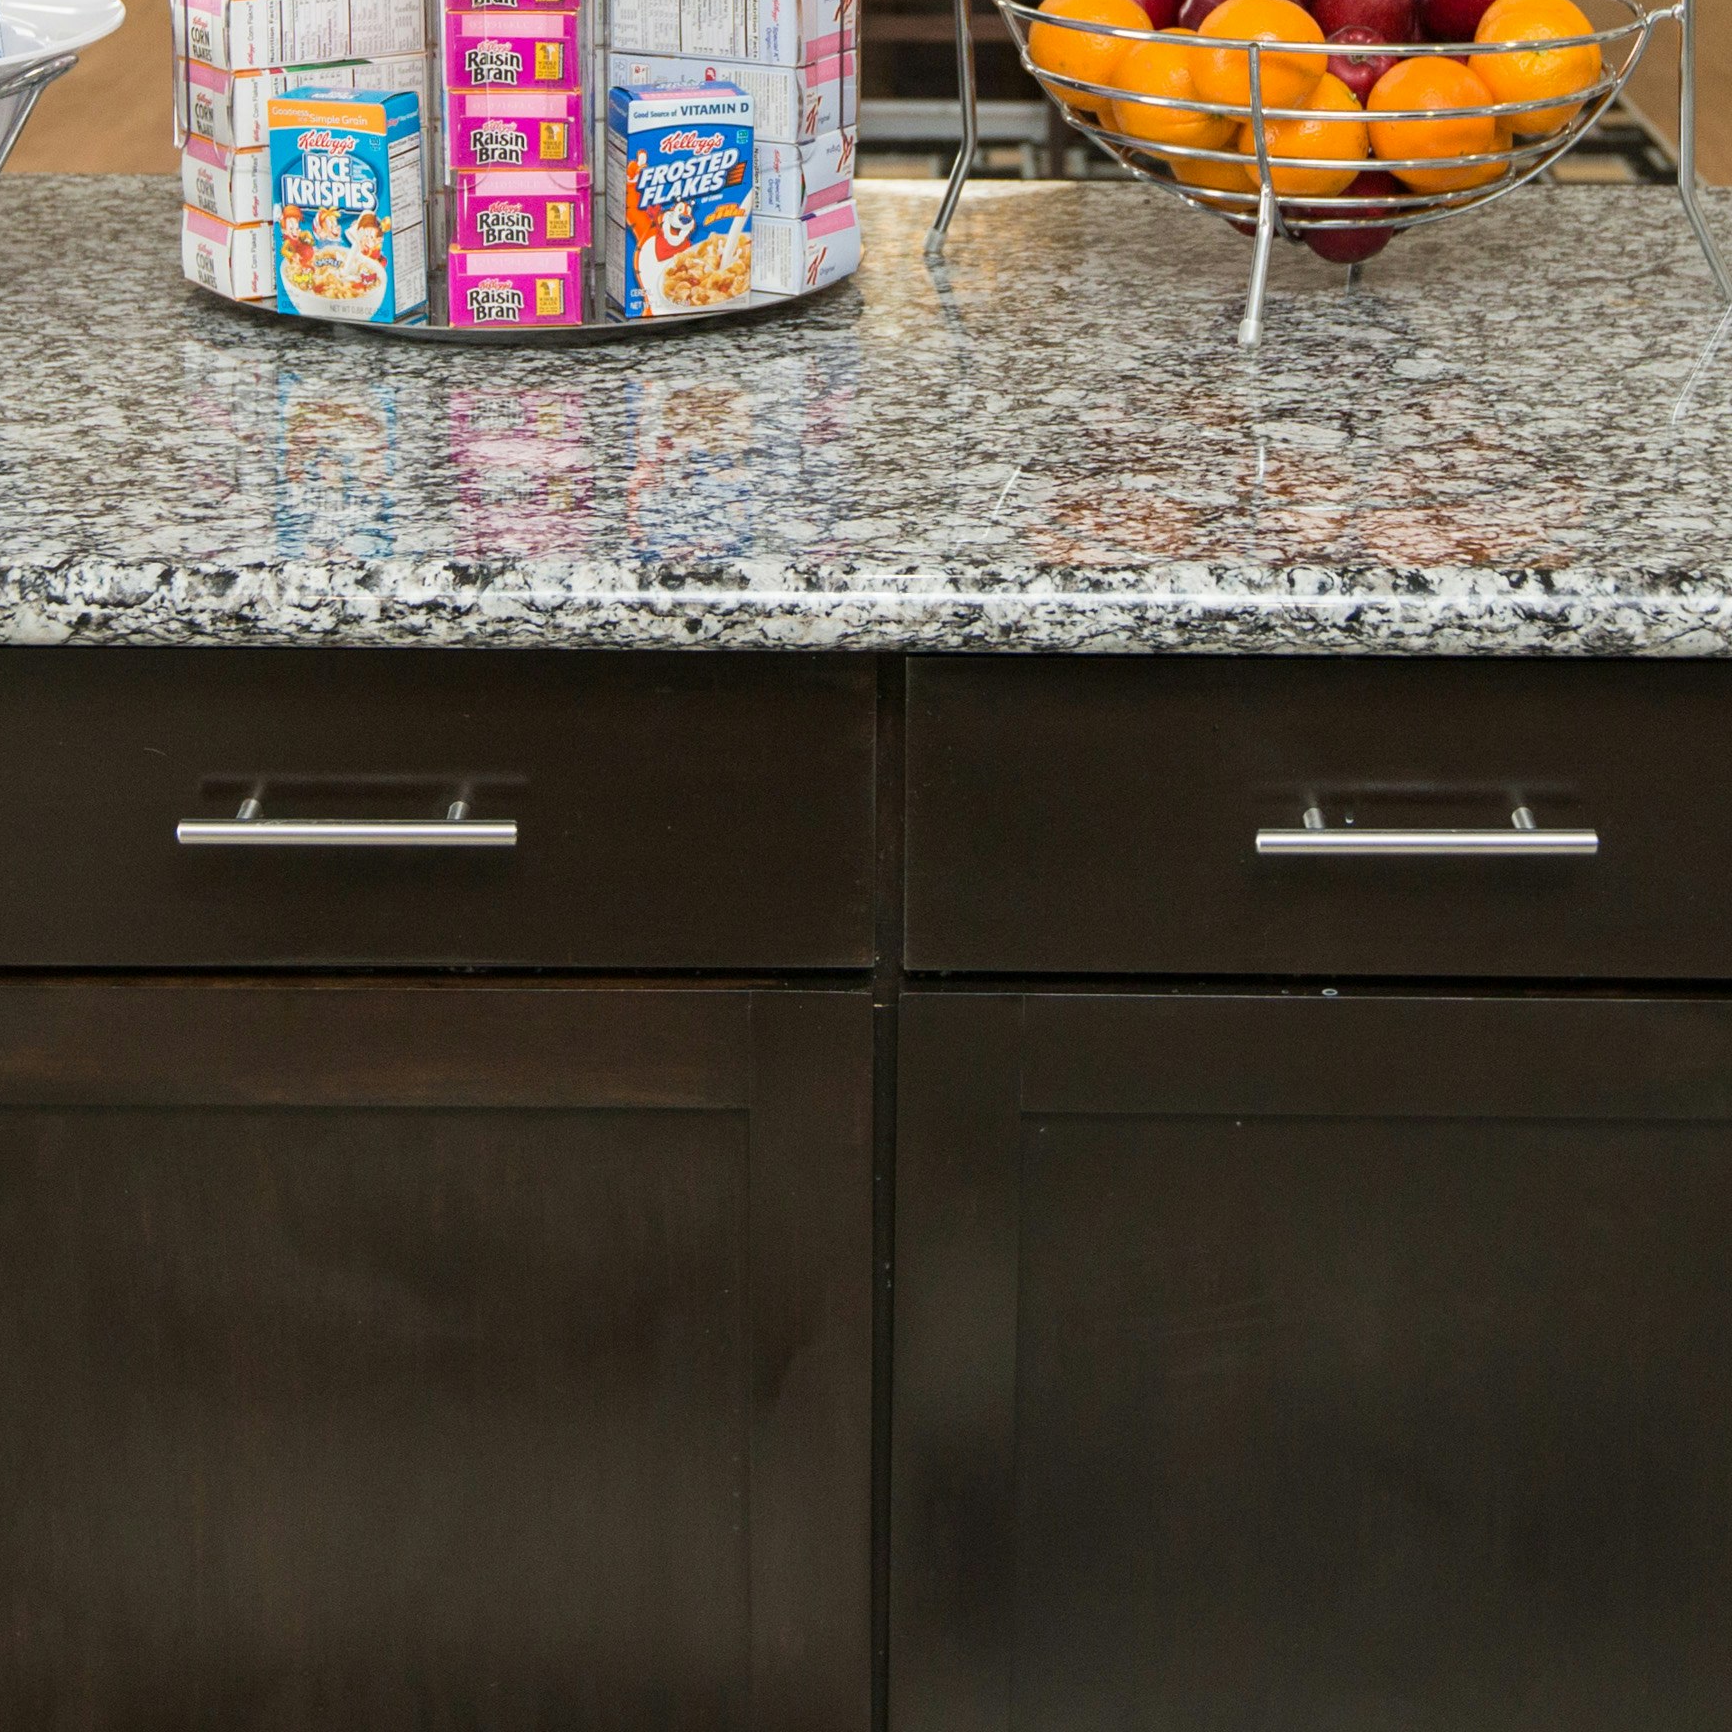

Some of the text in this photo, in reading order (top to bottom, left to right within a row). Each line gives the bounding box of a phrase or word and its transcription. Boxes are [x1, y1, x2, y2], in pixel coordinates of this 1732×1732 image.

[191, 27, 210, 46] CORN
[467, 51, 521, 70] Raisin
[473, 68, 516, 84] Bran
[195, 103, 214, 119] CORN
[633, 111, 649, 119] Good
[650, 110, 670, 118] Source
[680, 102, 736, 116] VITAMIN
[740, 102, 750, 113] D
[310, 114, 341, 125] Simple
[342, 115, 368, 126] Grain
[298, 131, 356, 154] Kellogg's
[472, 131, 526, 149] Raisin
[661, 131, 724, 154] Kellogg's
[478, 147, 521, 163] Bran
[306, 155, 351, 182] RICE
[637, 149, 739, 189] FROSTED
[196, 178, 215, 197] CORN
[285, 176, 377, 210] KRISPIES
[639, 170, 726, 208] FLAKES
[479, 212, 533, 230] Raisin
[485, 228, 528, 244] Bran
[196, 252, 215, 273] CORN
[469, 290, 523, 308] Raisin
[475, 306, 518, 321] Bran
